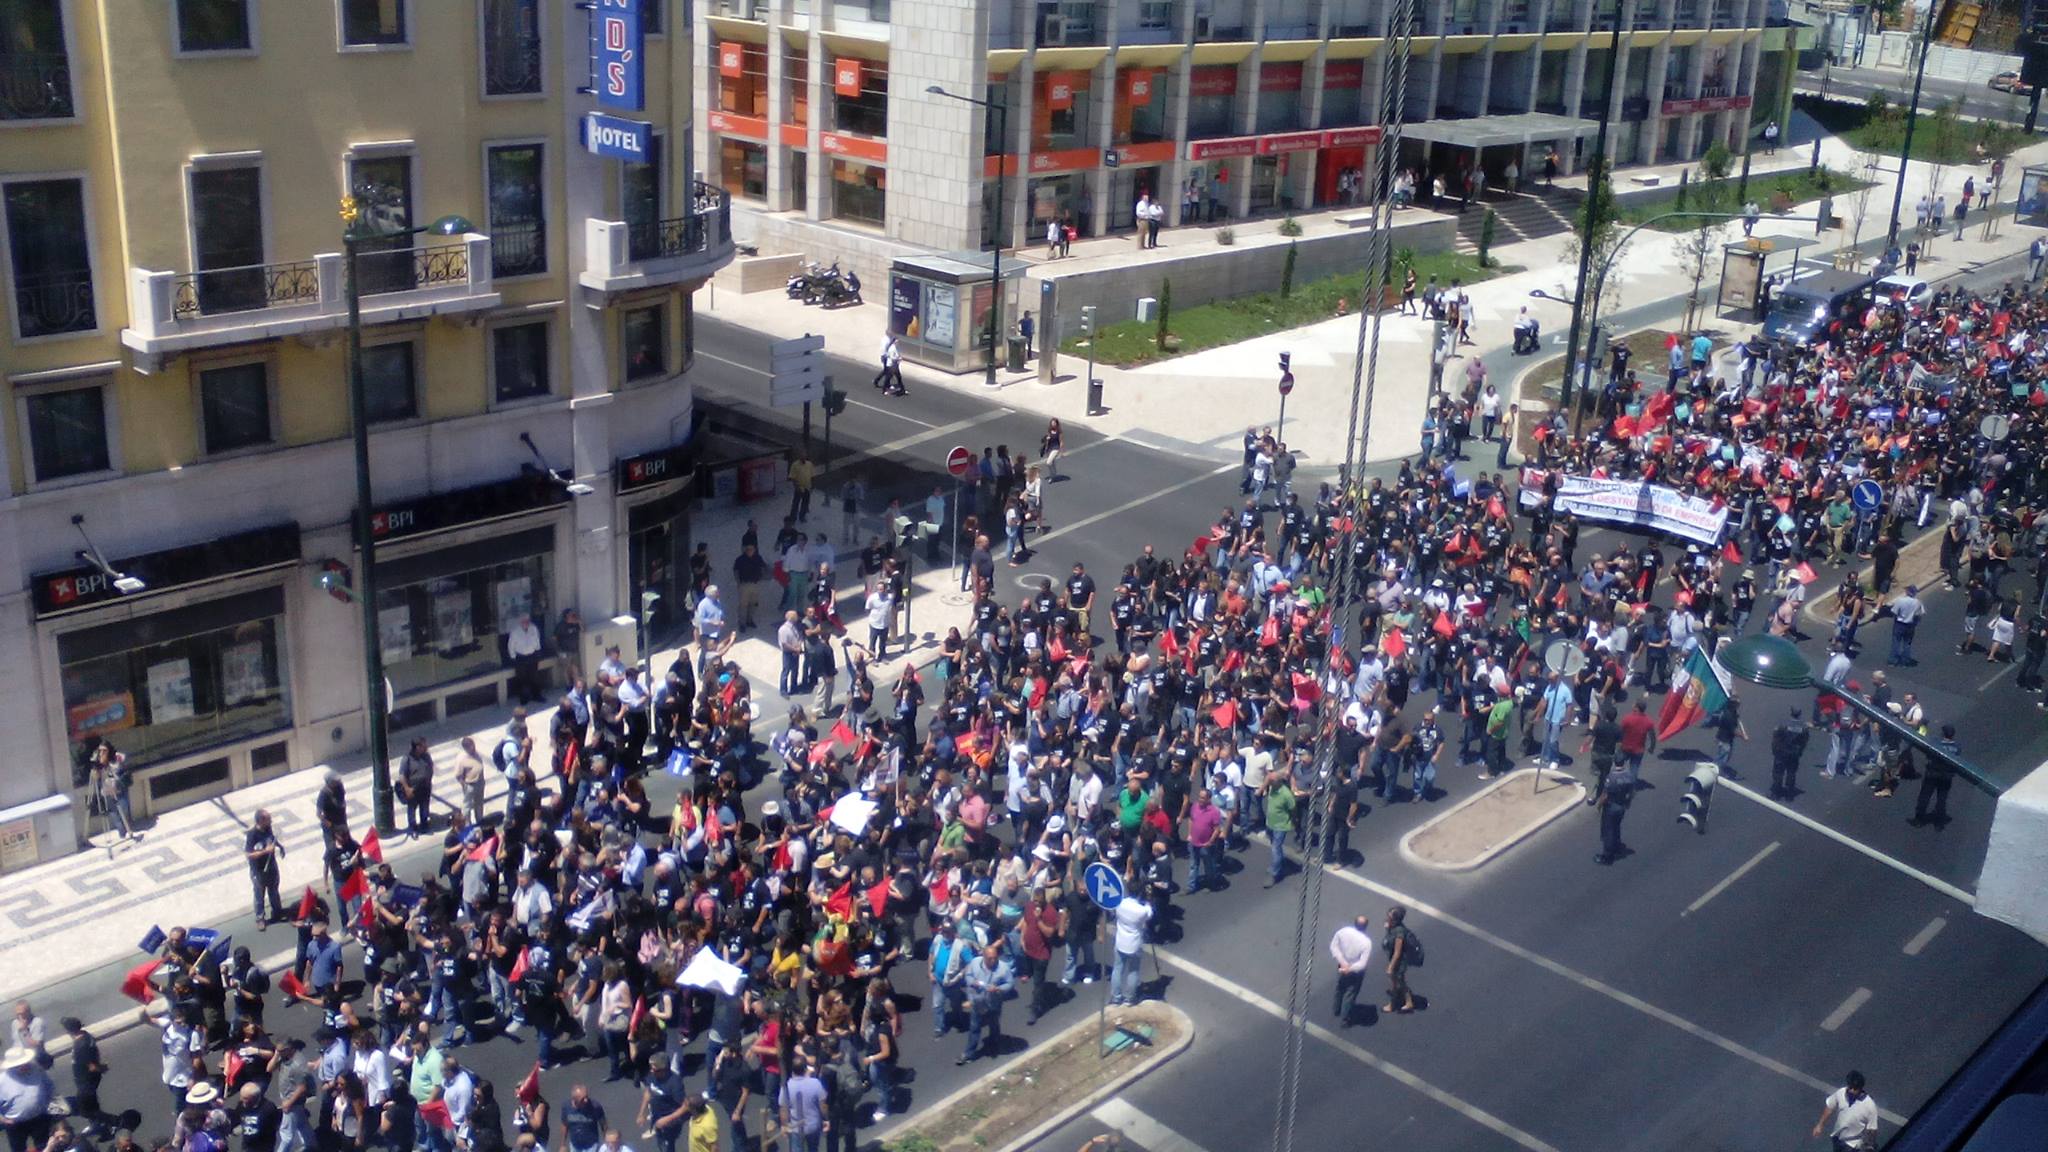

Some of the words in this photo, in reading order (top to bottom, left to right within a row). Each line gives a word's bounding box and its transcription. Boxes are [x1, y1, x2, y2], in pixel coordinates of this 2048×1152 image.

[590, 126, 642, 153] HOTEL
[645, 460, 666, 476] BPI
[1598, 495, 1658, 512] DESTRUO
[388, 510, 414, 529] BPI
[75, 574, 107, 596] BPI
